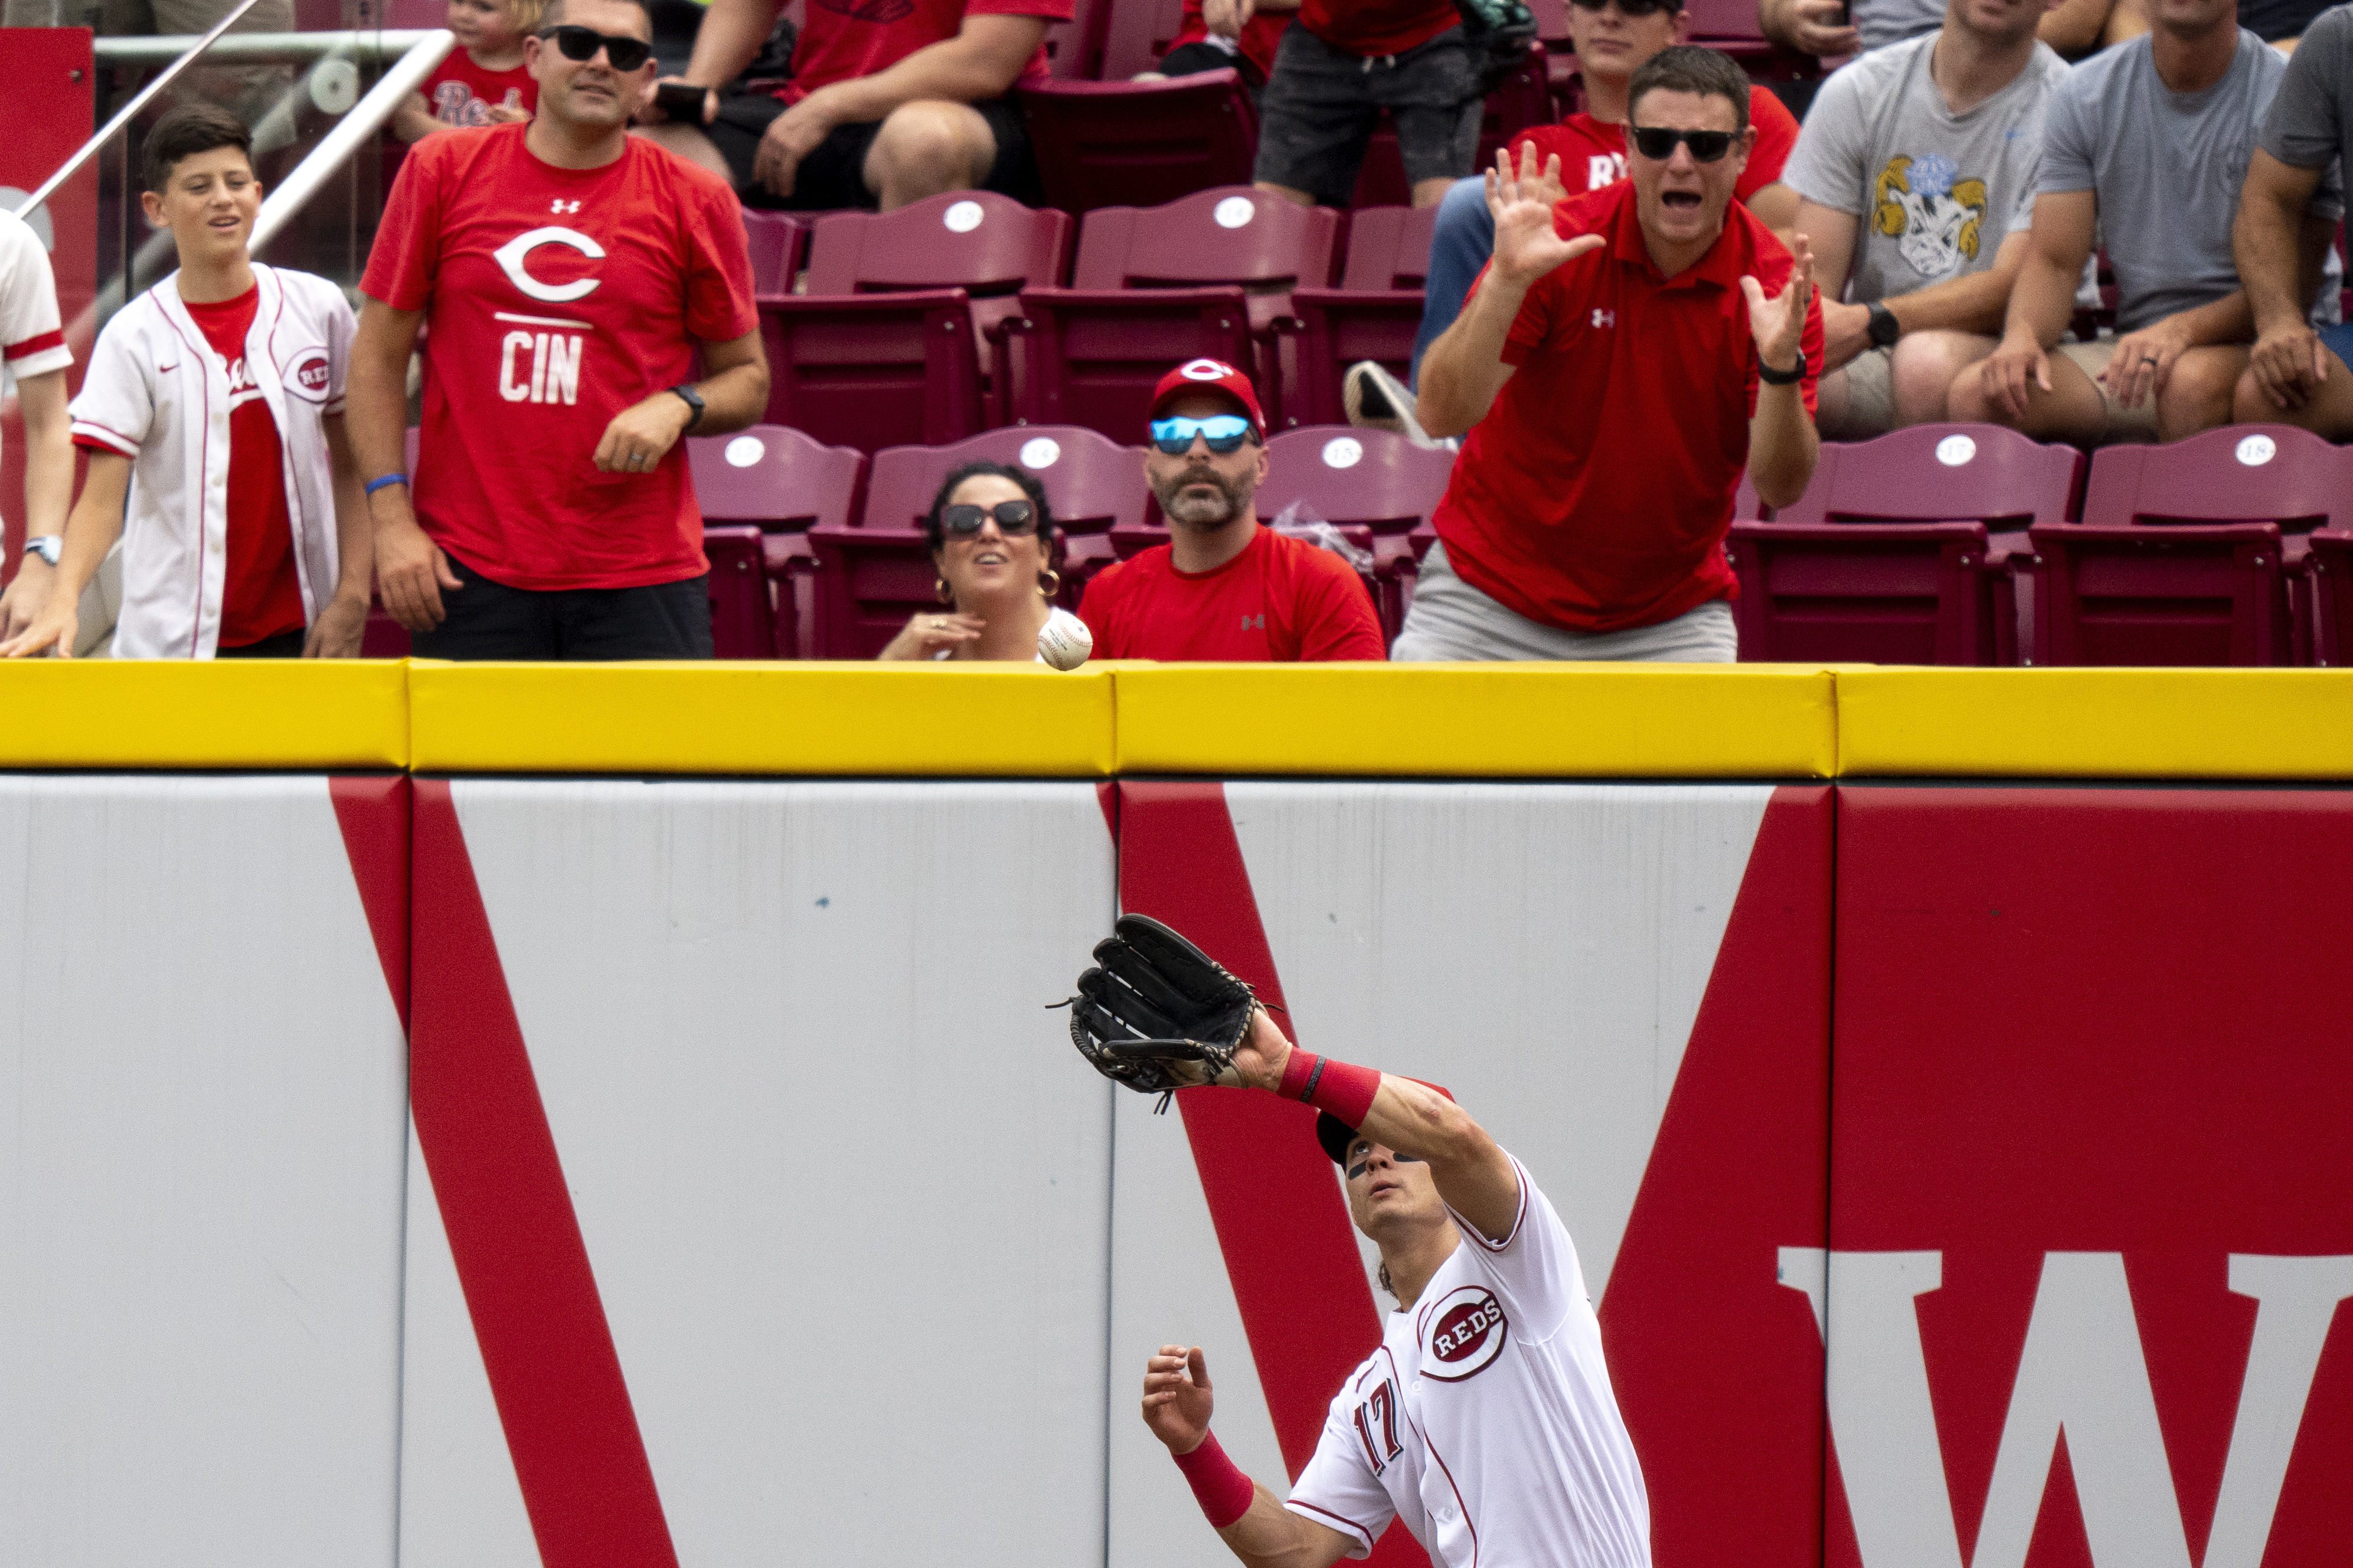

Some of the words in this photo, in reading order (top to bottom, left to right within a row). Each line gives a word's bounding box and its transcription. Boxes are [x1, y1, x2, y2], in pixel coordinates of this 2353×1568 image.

[499, 330, 583, 405] CIN
[1434, 1298, 1502, 1357] REDS
[1354, 1377, 1404, 1477] 17
